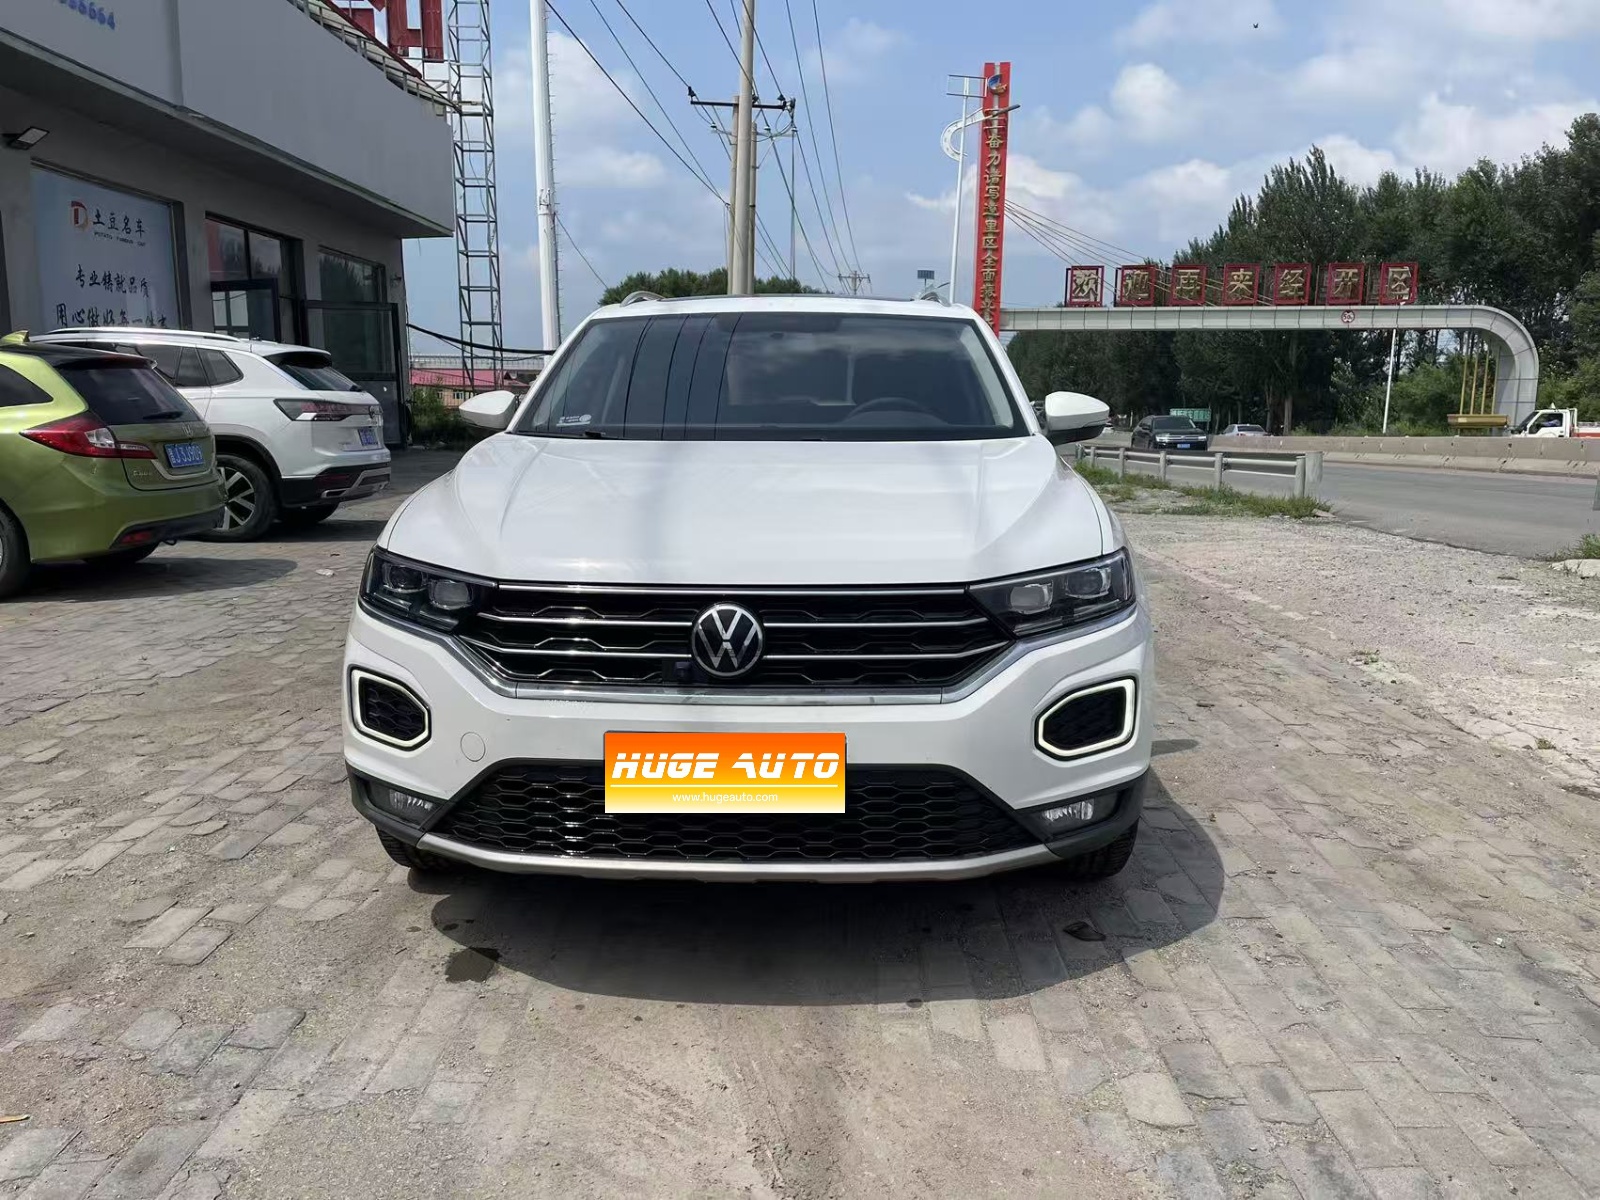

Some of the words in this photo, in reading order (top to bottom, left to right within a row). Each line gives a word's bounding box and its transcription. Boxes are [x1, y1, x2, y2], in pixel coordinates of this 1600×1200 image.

[93, 208, 145, 237] 土豆名车
[75, 263, 150, 298] 专业铸就品质
[1072, 267, 1412, 299] 欢迎再来经开区
